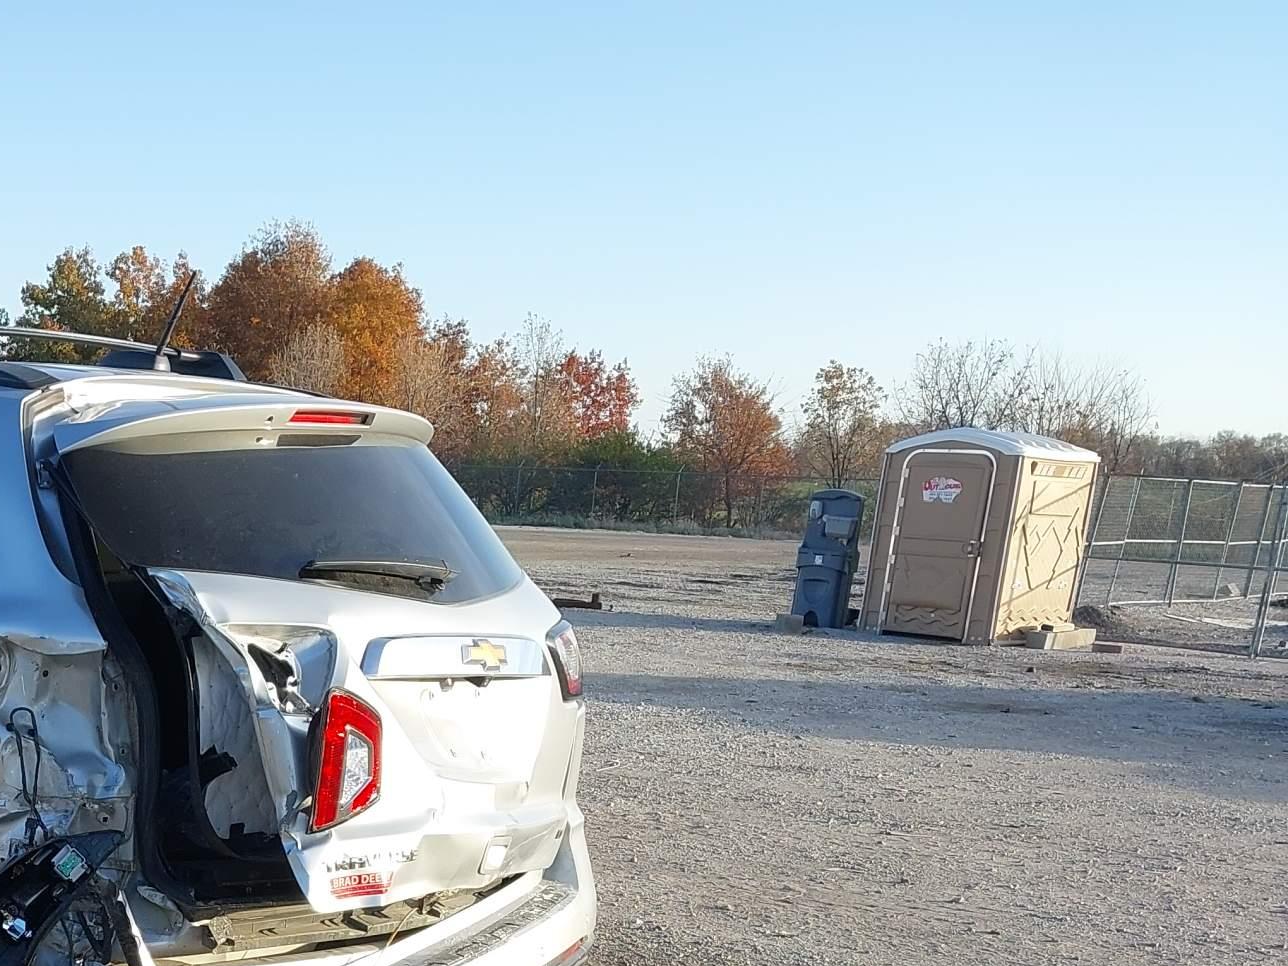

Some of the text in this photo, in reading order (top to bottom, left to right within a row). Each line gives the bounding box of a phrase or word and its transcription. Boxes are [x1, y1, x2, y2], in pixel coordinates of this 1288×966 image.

[321, 849, 418, 873] TRAVSE
[333, 876, 359, 888] BRAD
[361, 872, 392, 884] DEE
